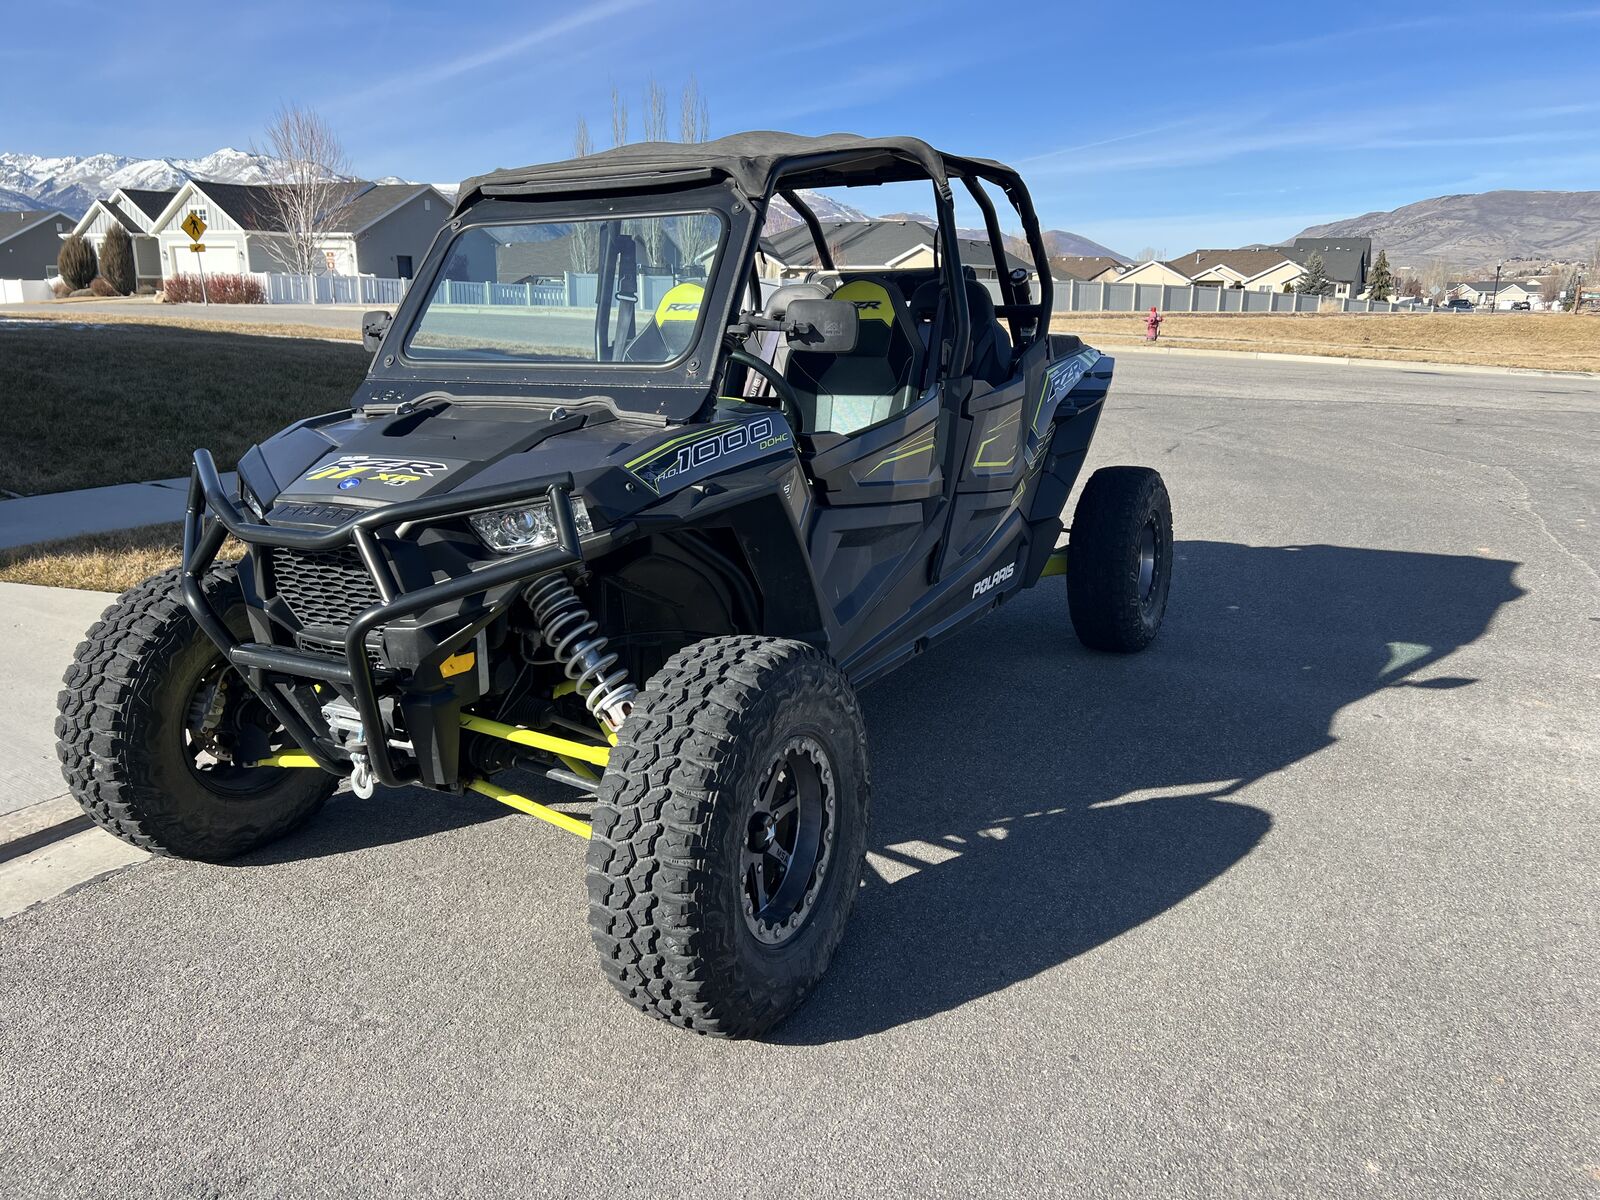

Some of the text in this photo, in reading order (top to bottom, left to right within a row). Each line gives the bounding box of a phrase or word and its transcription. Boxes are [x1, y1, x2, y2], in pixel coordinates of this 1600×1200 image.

[677, 417, 773, 474] 1000
[759, 432, 789, 450] DOHC
[972, 561, 1015, 599] POLARIS
